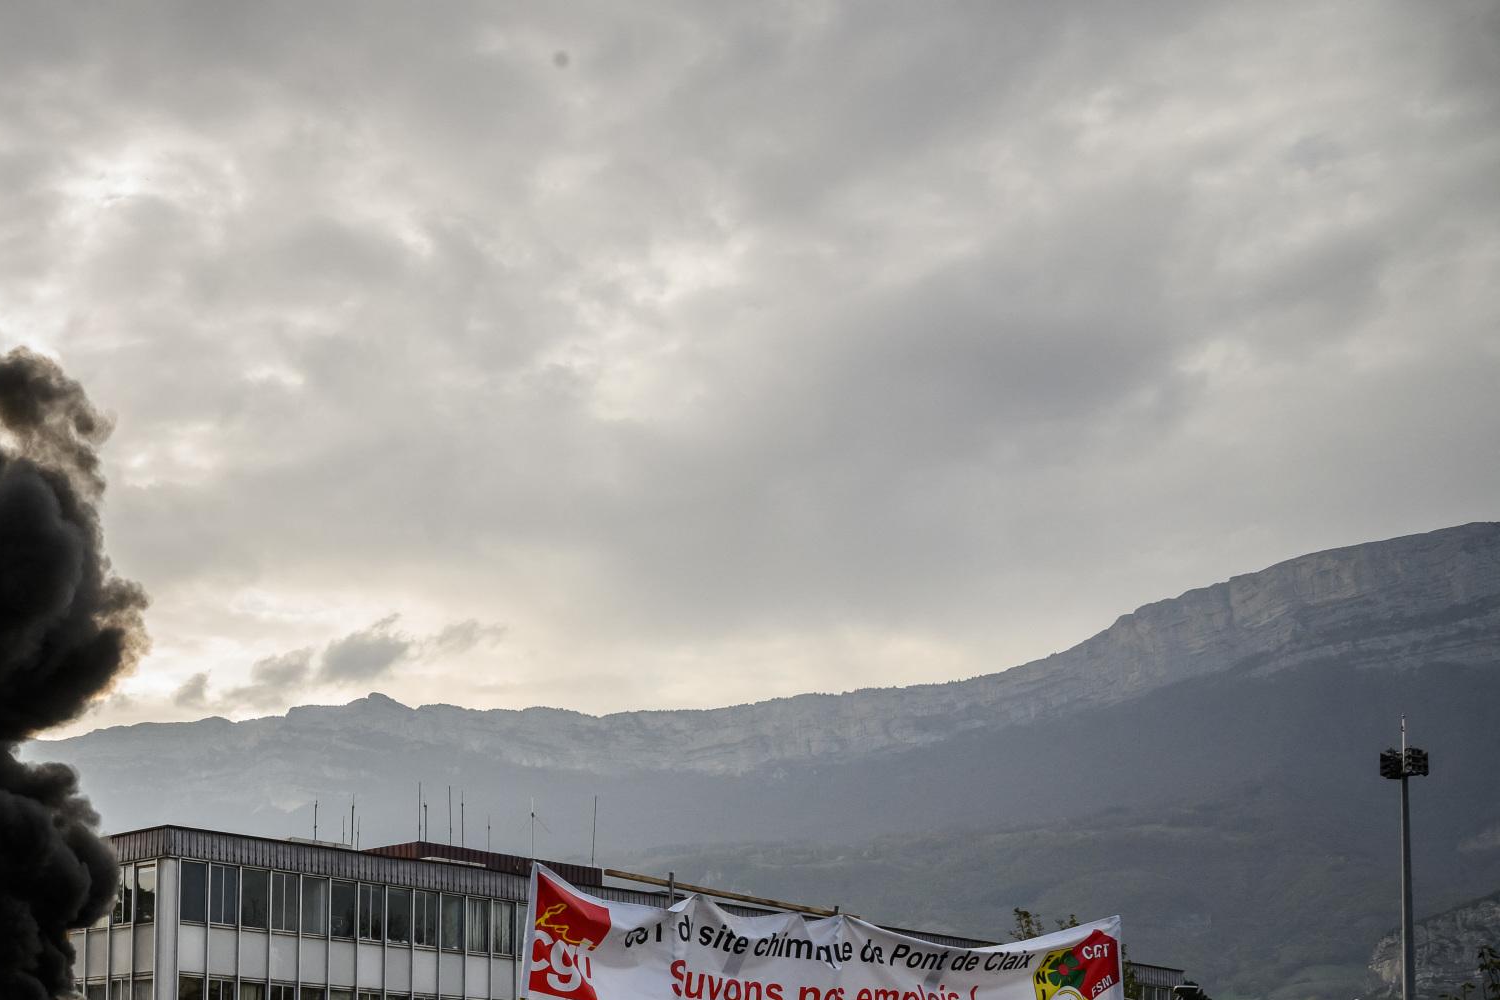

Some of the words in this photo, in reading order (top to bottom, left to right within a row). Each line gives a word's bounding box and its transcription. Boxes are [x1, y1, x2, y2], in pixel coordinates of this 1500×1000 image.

[699, 925, 748, 954] site
[890, 944, 949, 971] Pont
[951, 950, 979, 972] de
[984, 951, 1036, 972] Claix
[1081, 942, 1110, 960] CGT
[1091, 975, 1113, 998] FSM
